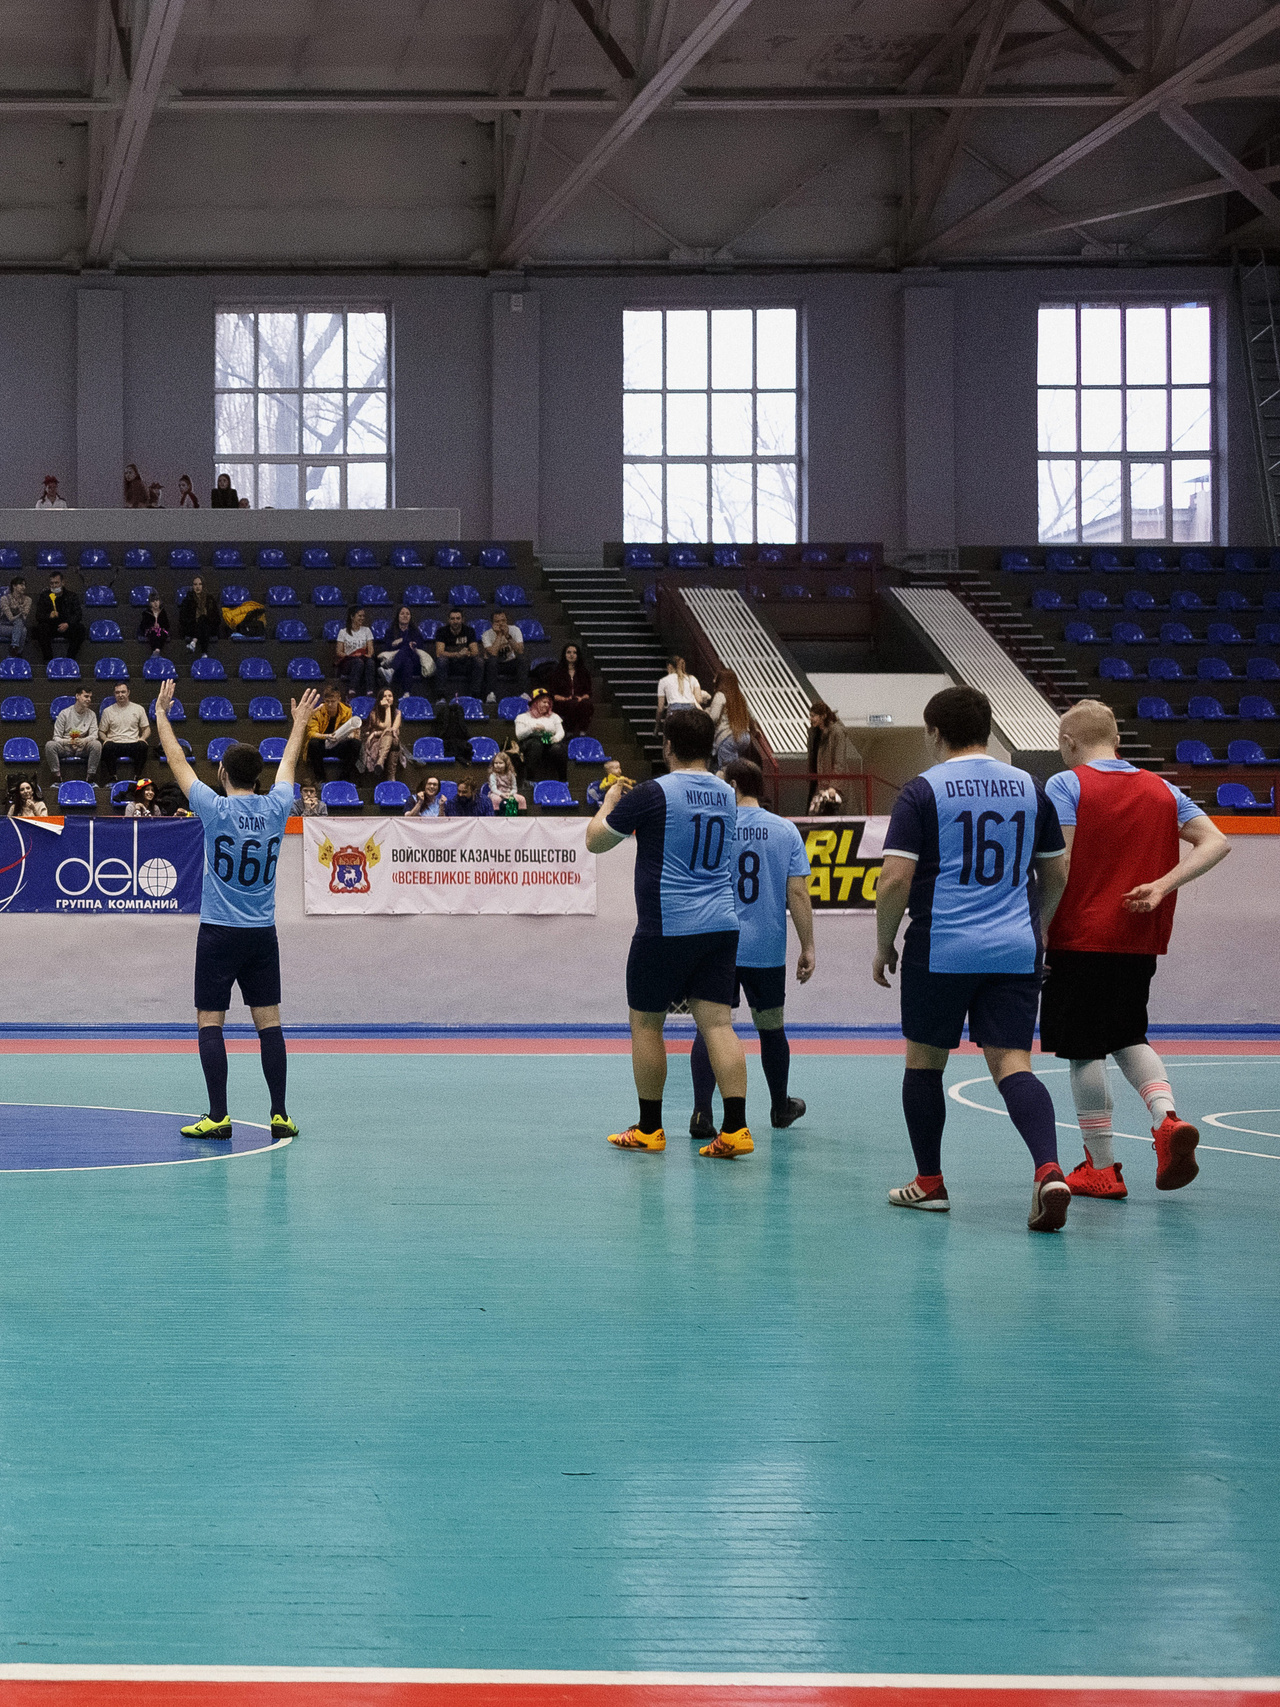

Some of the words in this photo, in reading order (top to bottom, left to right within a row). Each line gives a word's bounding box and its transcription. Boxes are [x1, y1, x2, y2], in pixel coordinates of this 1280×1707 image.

[945, 779, 1026, 798] DEGTYAREV
[686, 790, 728, 806] NIKOLAY
[238, 816, 265, 831] SATAN
[688, 813, 725, 871] 10
[954, 810, 1026, 886] 161
[214, 835, 280, 886] 666
[391, 846, 457, 863] ВОЙСКОВОЕ
[460, 849, 511, 863] КАЗАЧЬЕ
[514, 849, 576, 864] ОБЩЕСТВО
[391, 870, 471, 885] «ВСЕВЕЛИКОЕ
[474, 868, 519, 885] ВОЙСКО
[521, 870, 581, 886] ДОНСКОЕ»
[738, 851, 759, 904] 8
[56, 899, 102, 909] ГРУППА
[108, 897, 178, 909] КОМПАНИЙ
